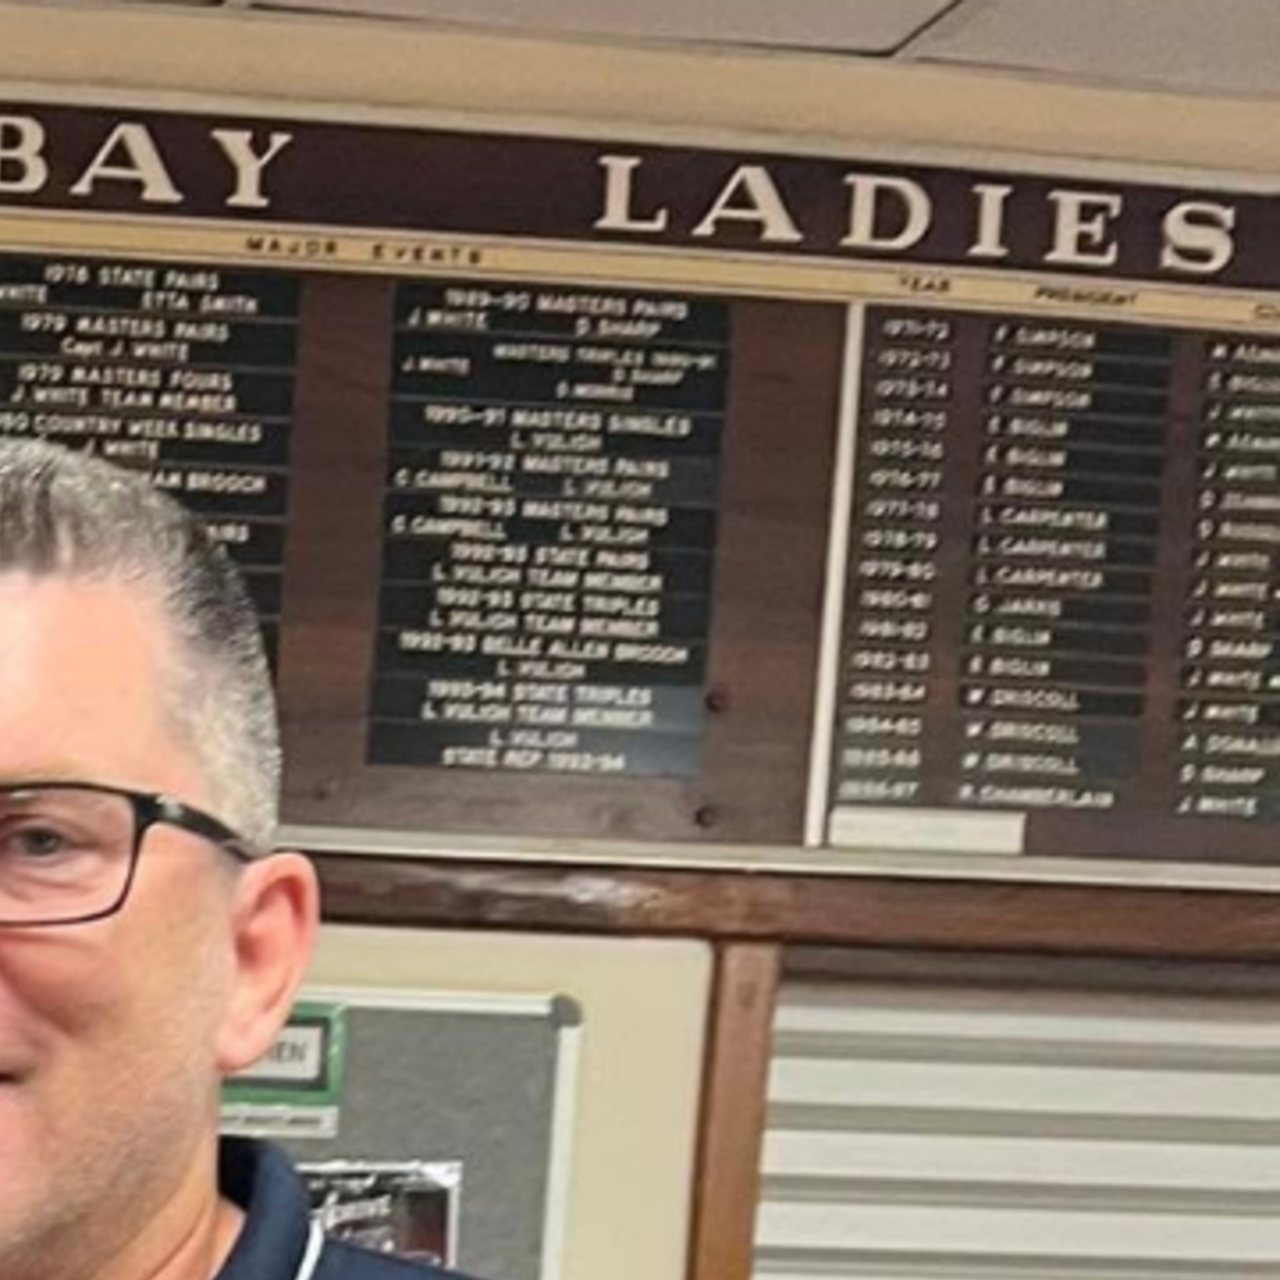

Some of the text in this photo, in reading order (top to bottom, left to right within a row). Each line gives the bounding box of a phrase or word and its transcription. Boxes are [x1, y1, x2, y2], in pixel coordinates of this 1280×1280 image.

[245, 236, 482, 265] MAJOR EVENTS
[597, 154, 1238, 273] LADIES
